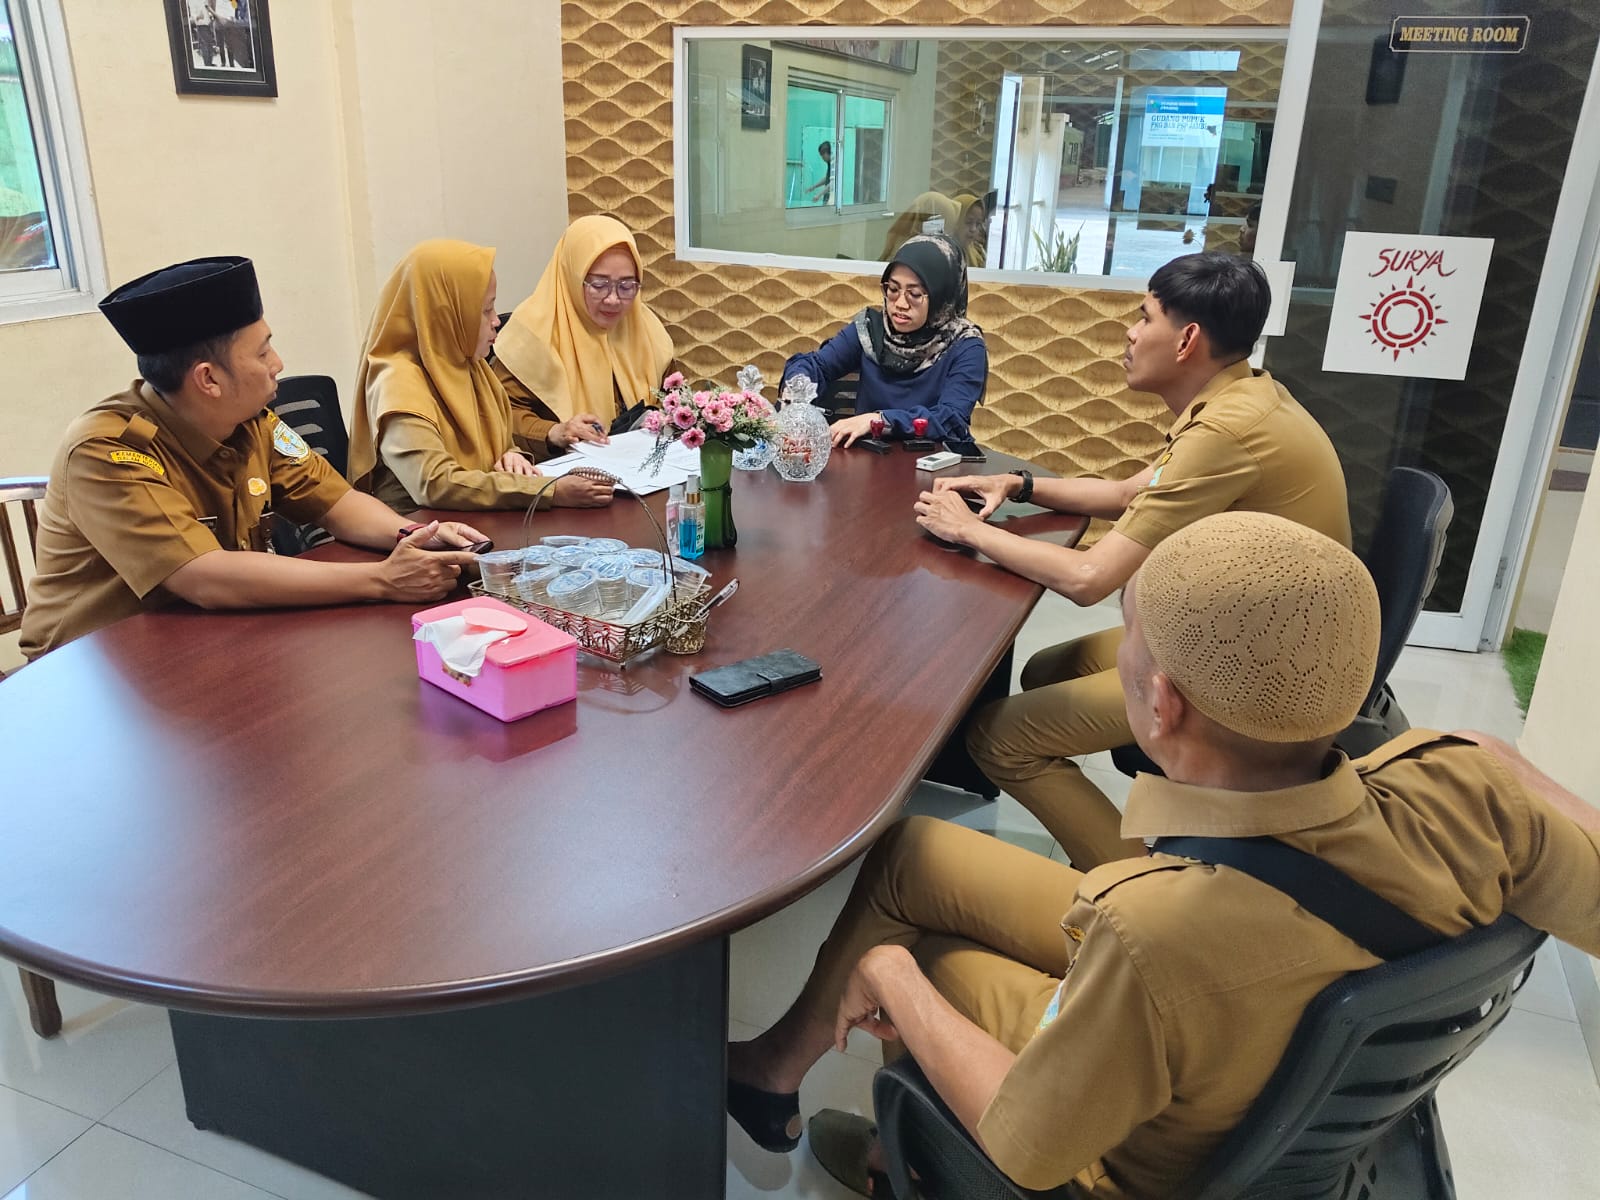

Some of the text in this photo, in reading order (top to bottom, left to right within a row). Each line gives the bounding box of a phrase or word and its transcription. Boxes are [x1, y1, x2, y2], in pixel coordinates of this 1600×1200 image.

[1400, 26, 1519, 43] MEETING ROOM
[1368, 248, 1457, 277] SURYA
